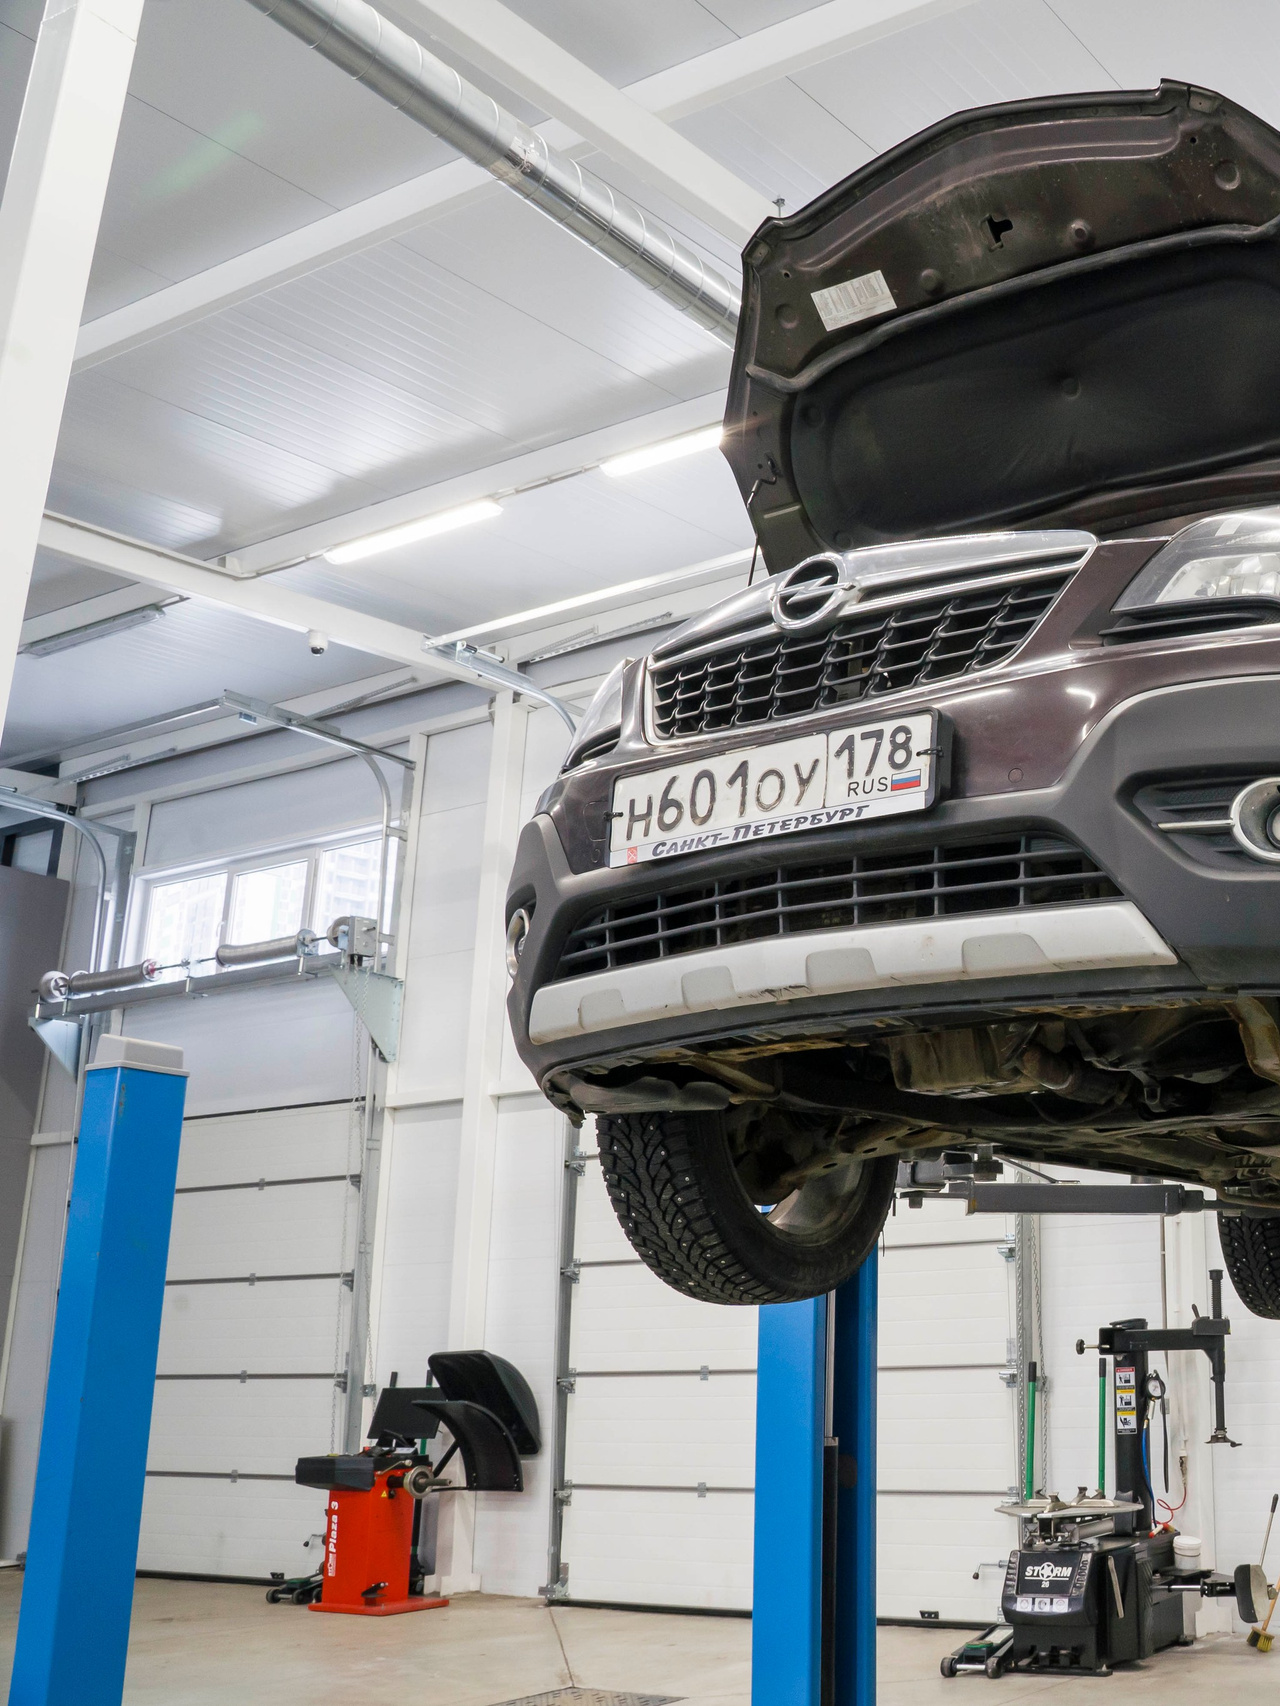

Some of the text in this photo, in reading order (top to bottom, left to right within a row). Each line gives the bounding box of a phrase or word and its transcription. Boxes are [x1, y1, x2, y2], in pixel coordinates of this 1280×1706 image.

[834, 725, 913, 779] 178
[847, 776, 888, 798] RUS
[331, 1501, 339, 1510] 3
[329, 1514, 338, 1553] Plaza
